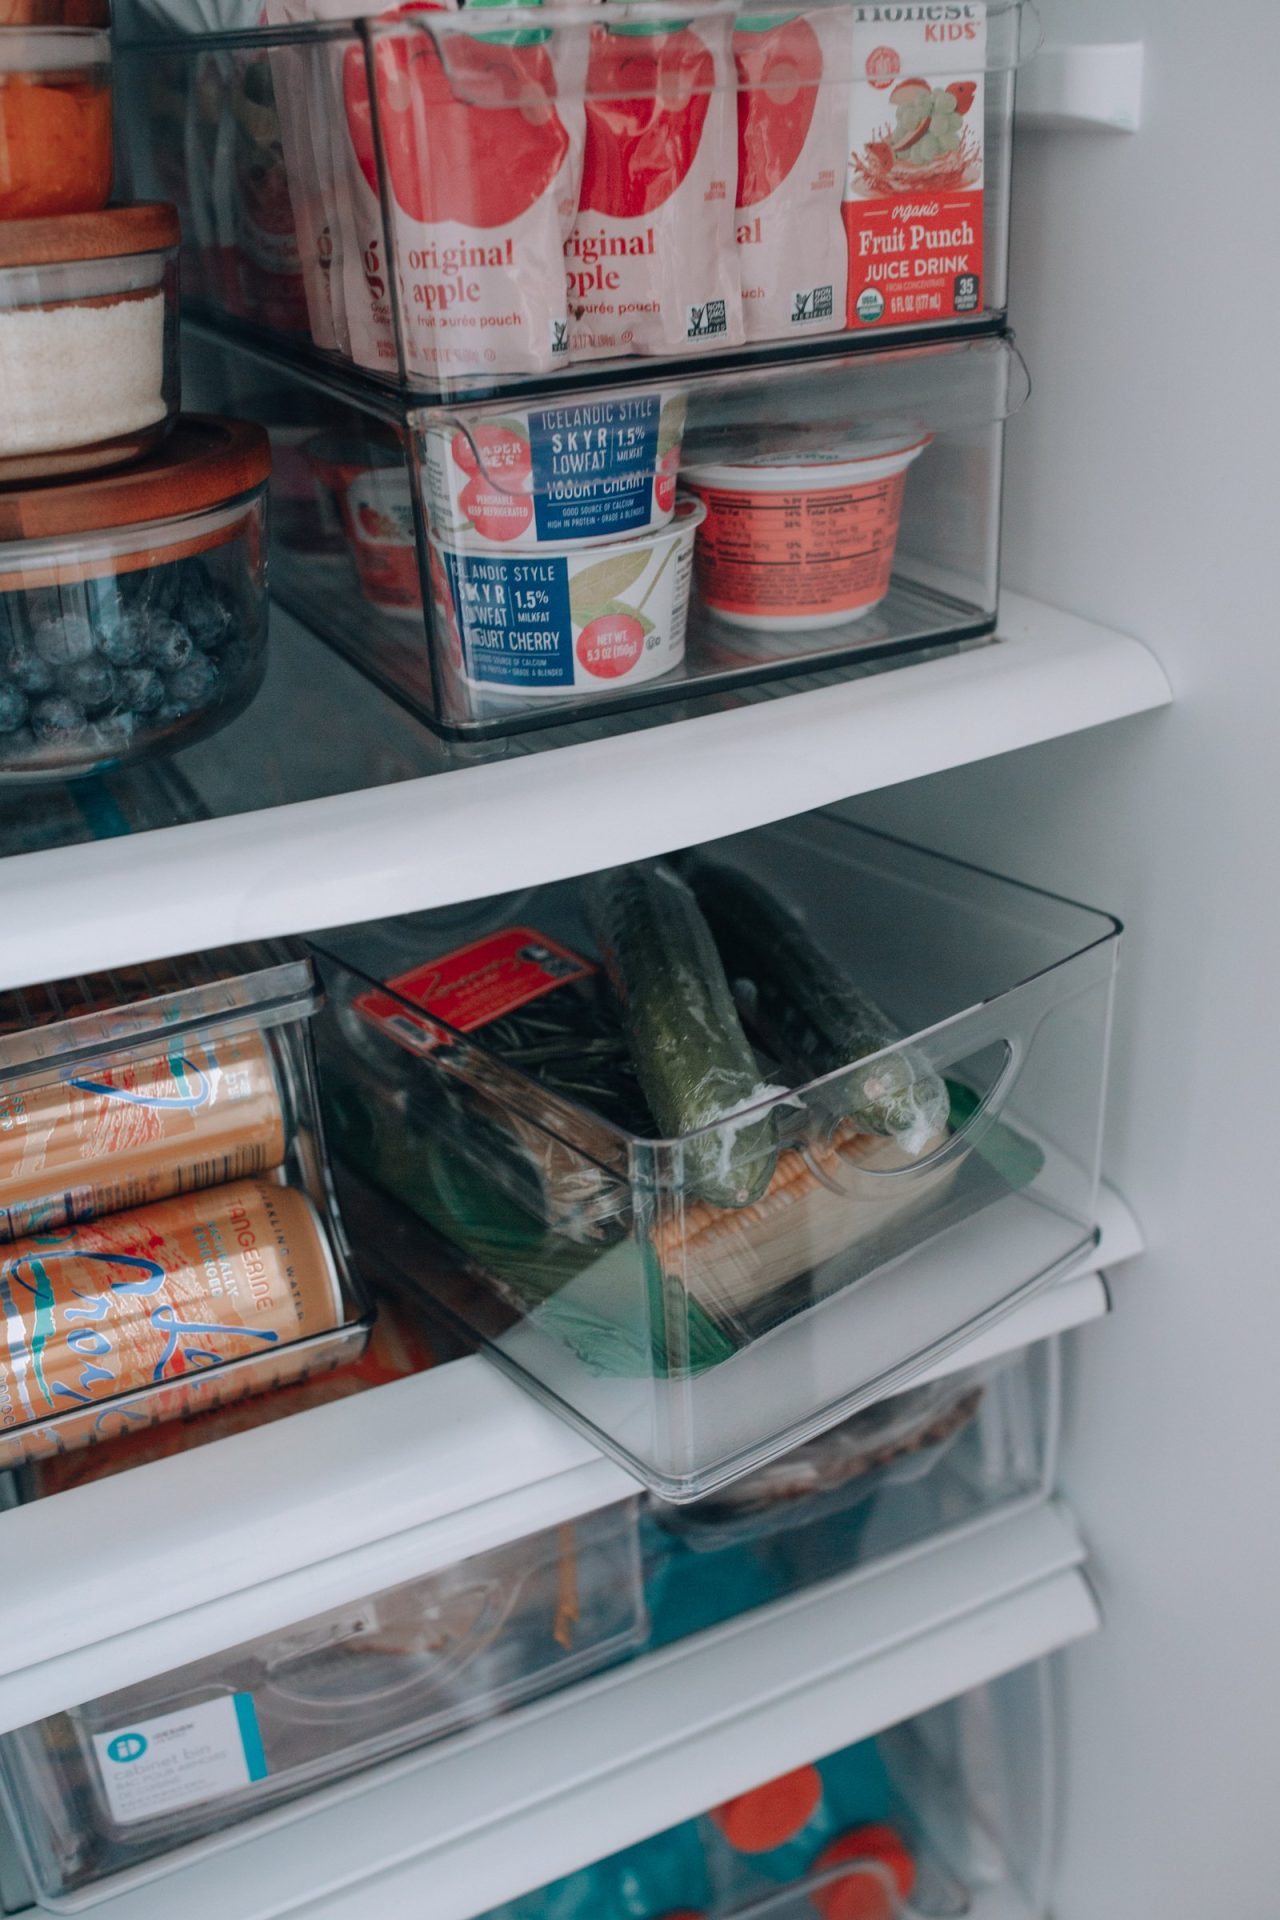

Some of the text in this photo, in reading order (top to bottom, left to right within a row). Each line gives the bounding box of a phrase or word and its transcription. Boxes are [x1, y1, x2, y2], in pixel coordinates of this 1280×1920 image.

[924, 23, 977, 42] KIDS
[891, 201, 939, 222] organic
[562, 228, 655, 264] riginal
[859, 220, 973, 256] Fruit Punch
[409, 239, 514, 276] original
[865, 255, 968, 282] JUICE DRINK
[565, 264, 621, 297] pple
[960, 278, 973, 295] 35
[413, 276, 481, 311] apple
[741, 289, 766, 300] uch
[618, 301, 661, 316] pouch
[480, 312, 522, 329] pouch
[542, 400, 653, 431] ICELANDIC STYLE
[463, 437, 522, 455] TADER
[552, 425, 646, 455] SKYR 1.5%
[552, 449, 607, 476] LOWFAT
[546, 481, 598, 501] YOGURT
[562, 506, 580, 517] GOOD
[581, 503, 602, 515] SOURCE
[603, 502, 612, 511] OF
[547, 519, 562, 529] HIGH
[563, 519, 571, 528] IN
[572, 516, 596, 527] PROTEIN
[513, 566, 556, 583] STYLE
[514, 590, 549, 609] 1.5%
[463, 604, 507, 627] WFAT
[517, 611, 551, 623] MILKFAT
[466, 628, 561, 651] GURT CHERRY
[597, 634, 612, 646] NET
[586, 649, 601, 662] 5.3
[601, 647, 612, 660] OZ
[228, 1199, 274, 1311] TANGERINE
[286, 1265, 305, 1322] WATER
